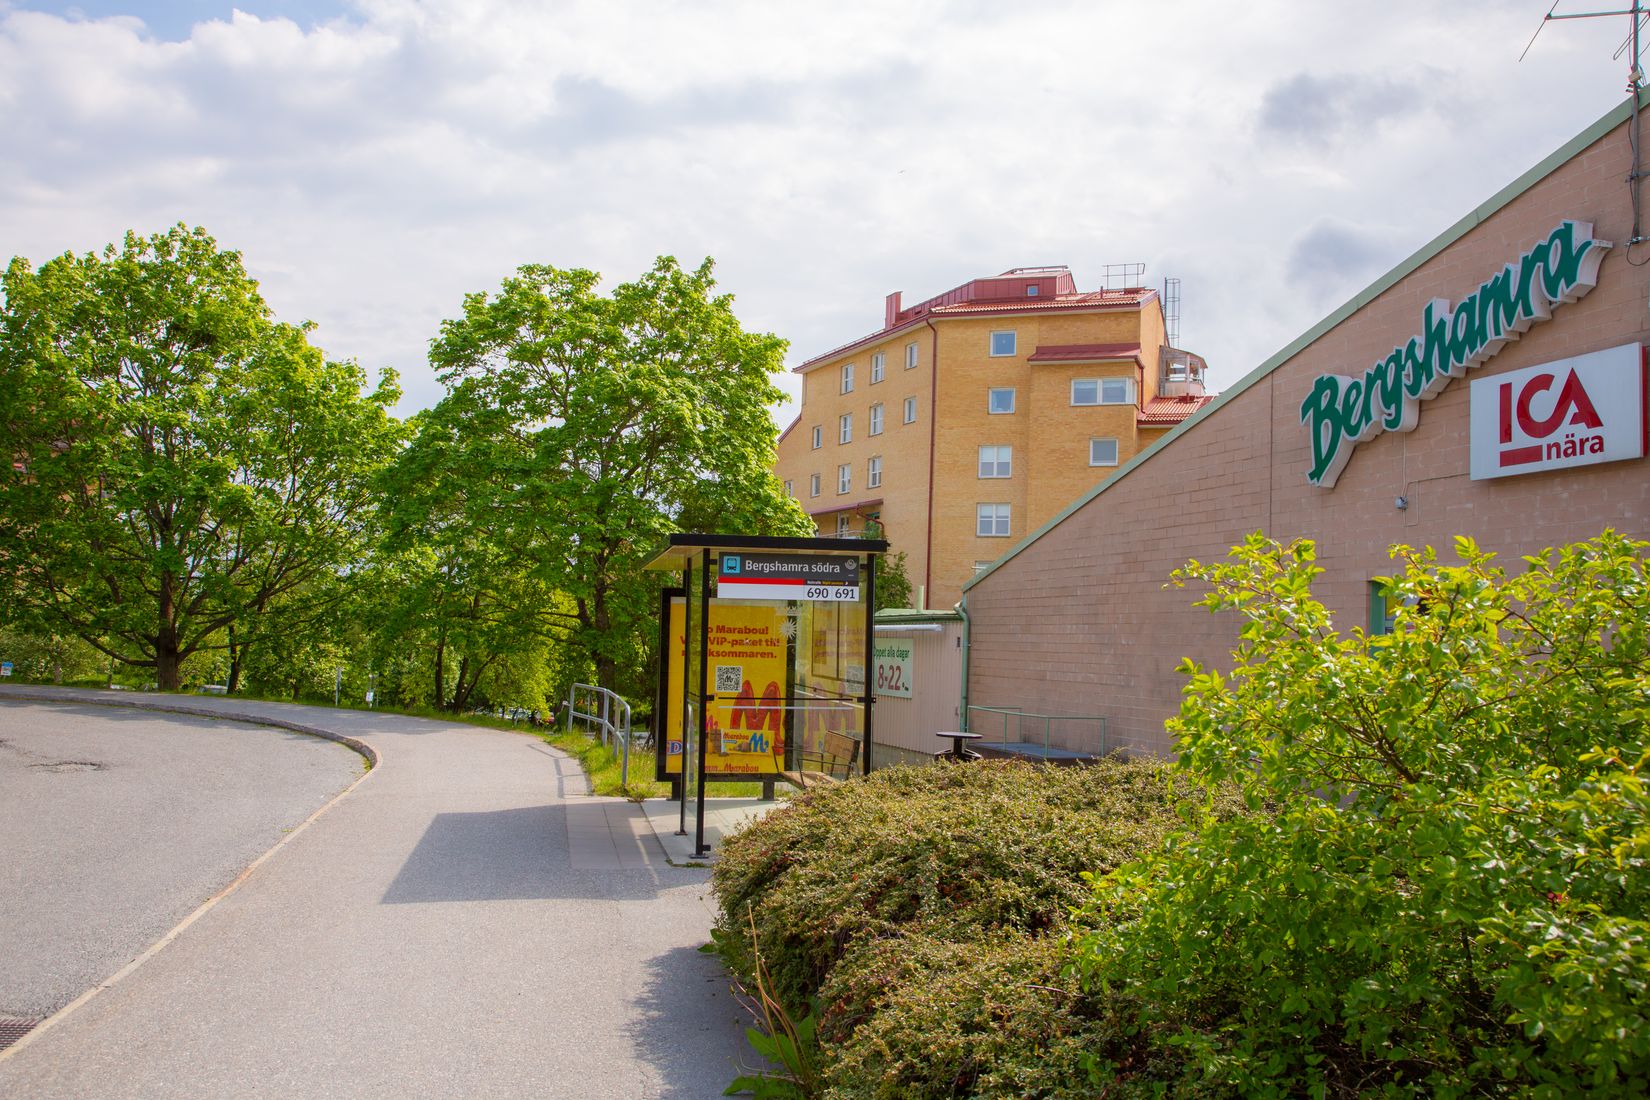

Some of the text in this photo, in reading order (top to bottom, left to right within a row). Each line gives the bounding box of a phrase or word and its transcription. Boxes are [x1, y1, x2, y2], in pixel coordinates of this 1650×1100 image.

[1301, 219, 1597, 484] Bergshamra
[1499, 367, 1604, 444] ICA
[1546, 433, 1604, 461] nära
[745, 559, 841, 573] Bergshamra södra
[807, 587, 855, 599] 690 691
